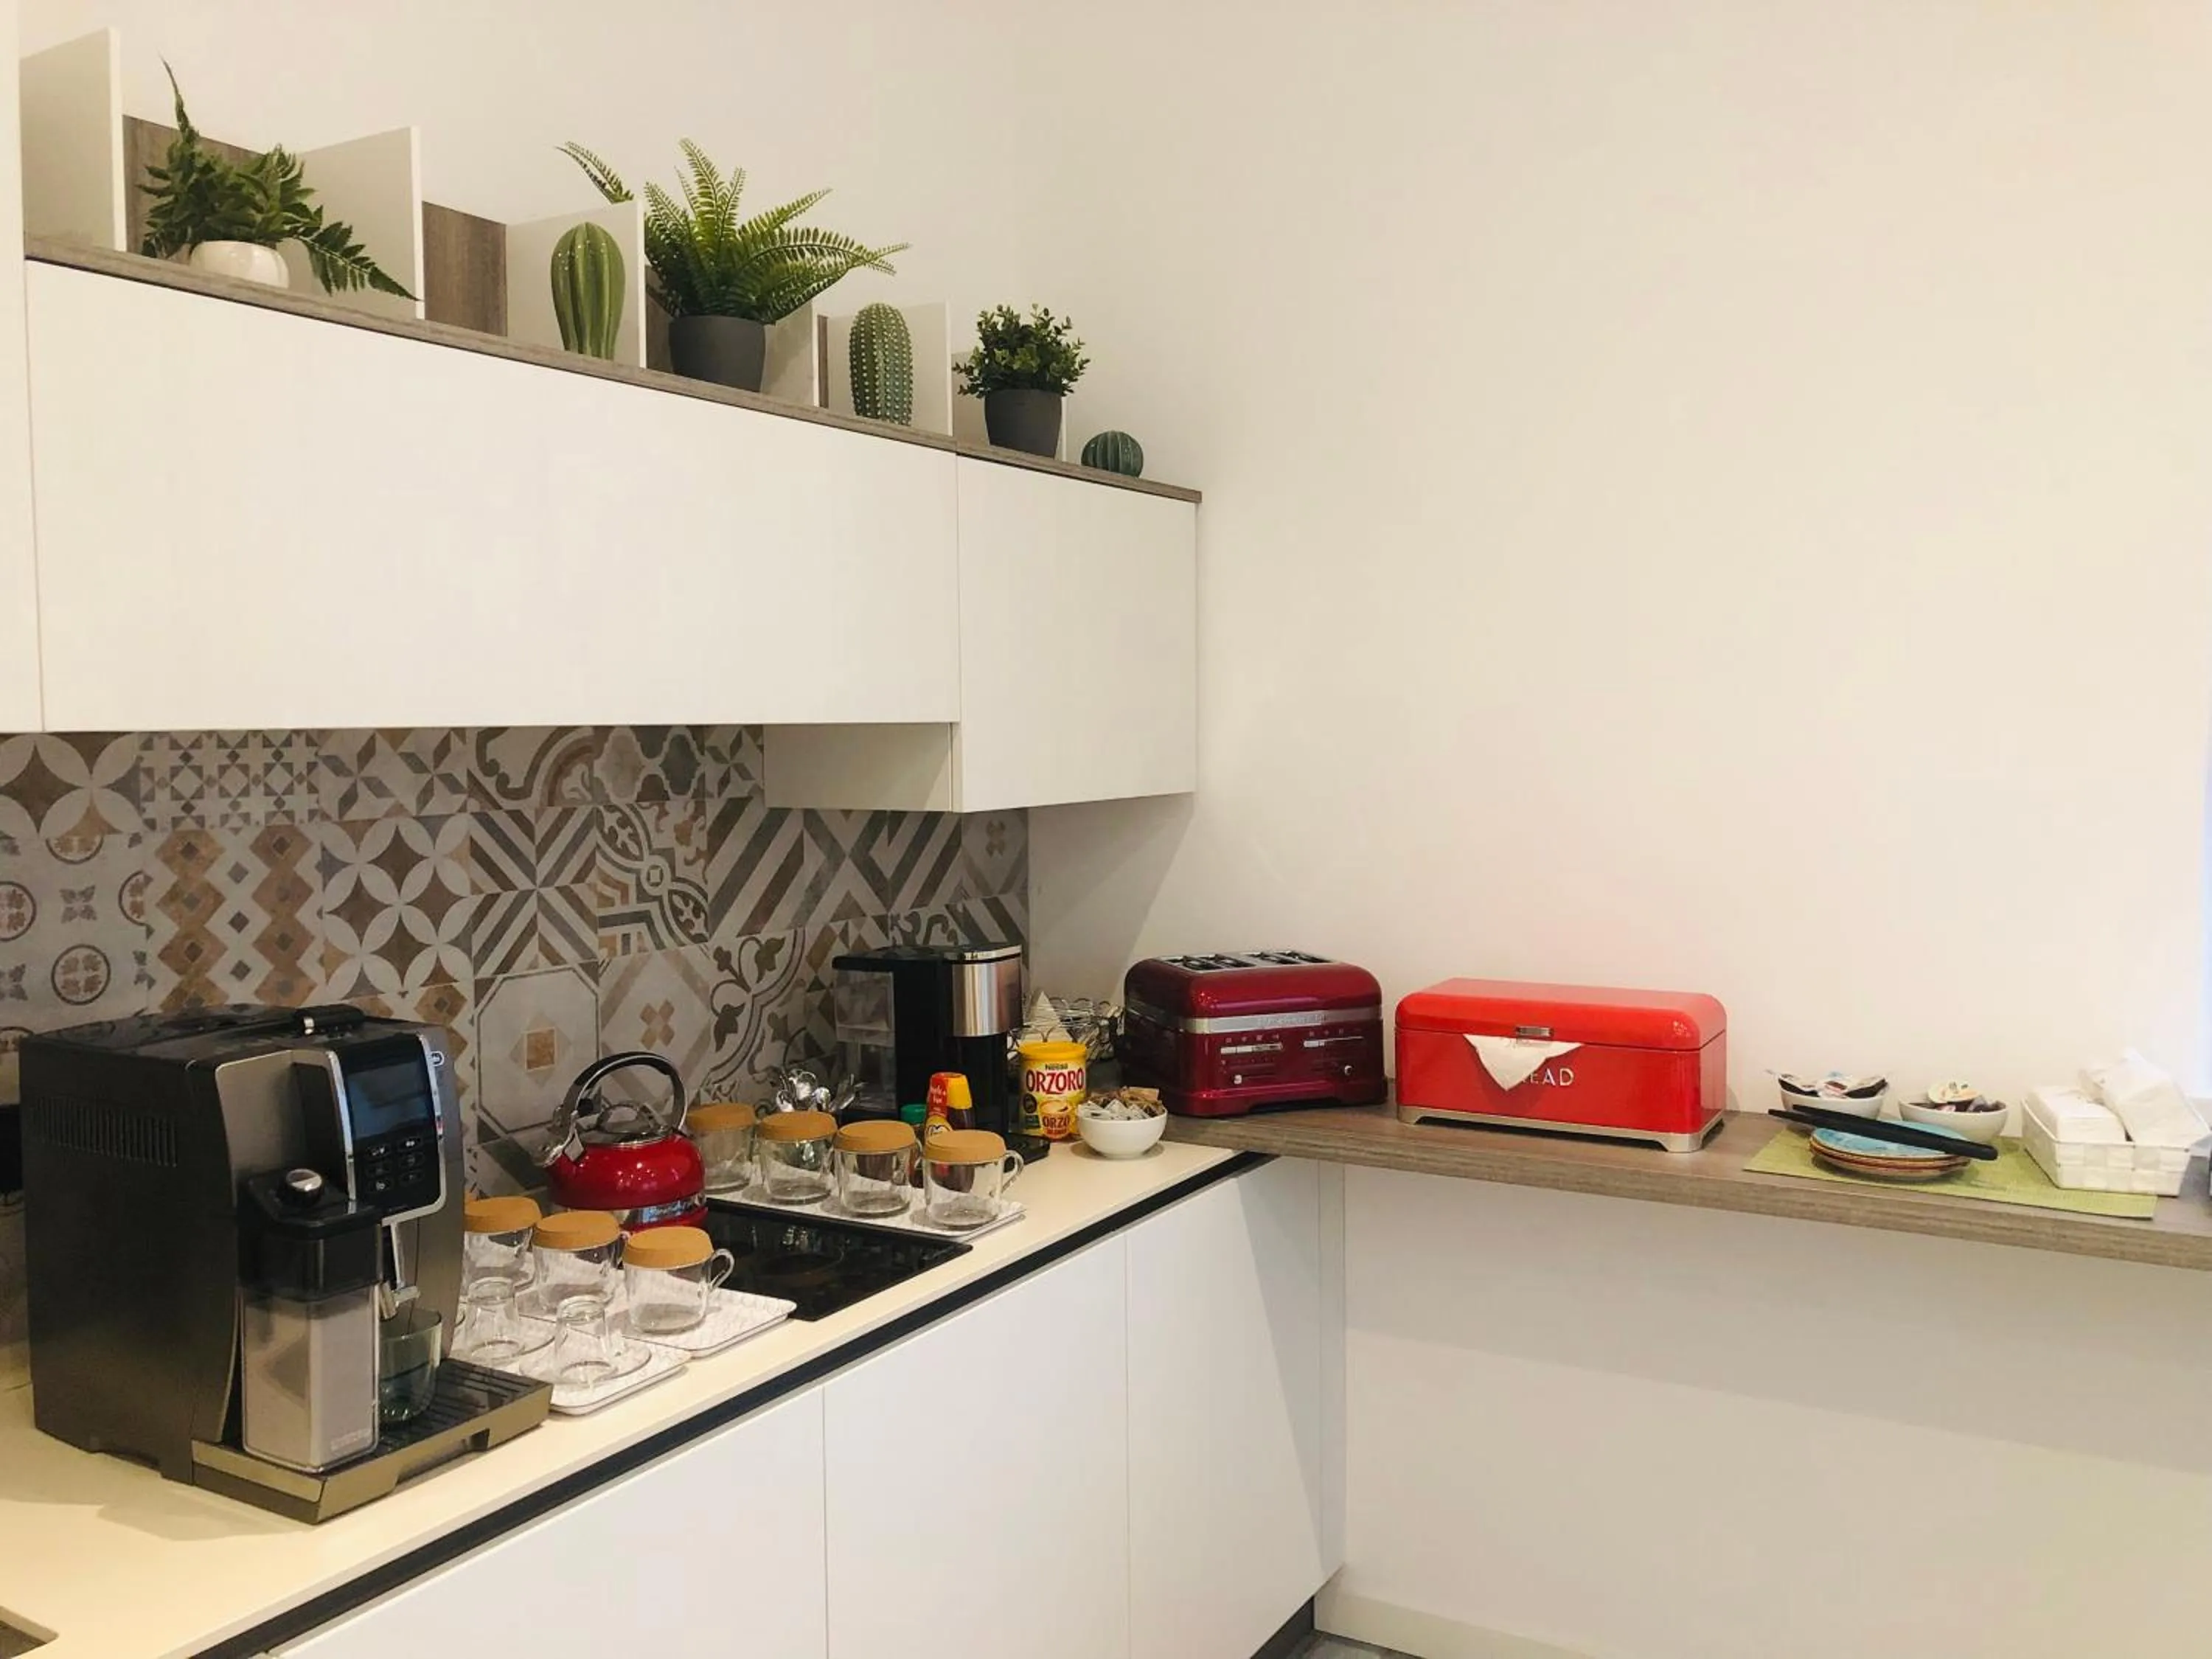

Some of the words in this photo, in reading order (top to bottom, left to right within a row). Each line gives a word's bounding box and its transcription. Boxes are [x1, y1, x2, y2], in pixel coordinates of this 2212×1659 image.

[1026, 1068, 1085, 1095] ORZORO
[1522, 1068, 1574, 1086] EAD
[1043, 1115, 1070, 1128] ORZO
